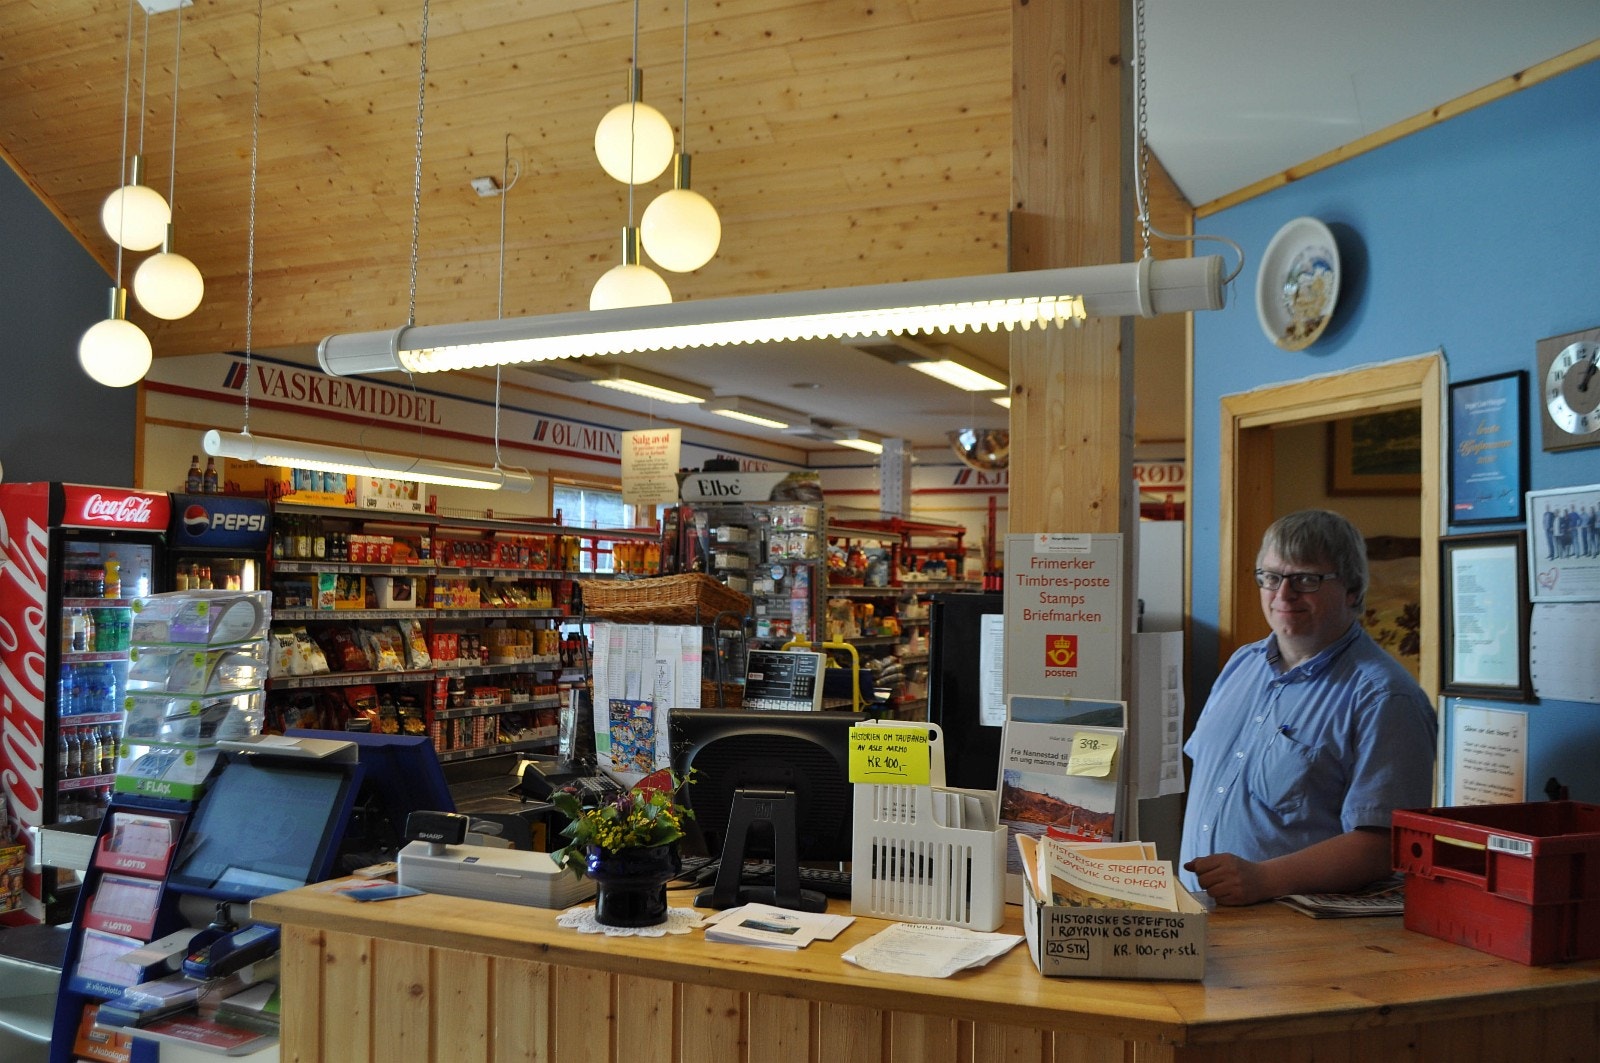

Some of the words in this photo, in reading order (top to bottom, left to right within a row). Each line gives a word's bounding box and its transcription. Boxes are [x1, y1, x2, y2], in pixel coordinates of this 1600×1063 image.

[256, 365, 442, 425] VASKEMIDDEL
[551, 420, 620, 454] ØL/MIN.
[83, 493, 153, 523] Coca-Cola
[211, 512, 266, 532] PEPSI
[1031, 557, 1095, 570] Frimerker
[1016, 574, 1110, 590] Timbres-poste
[1039, 591, 1085, 607] Stamps
[1023, 609, 1101, 622] Briefmarken
[1045, 669, 1078, 679] posten
[851, 732, 880, 741] HISTORIEN
[884, 733, 893, 741] OM
[869, 744, 883, 752] ASLE
[1010, 747, 1021, 755] Fra
[1023, 749, 1059, 760] Nannestad
[868, 755, 881, 767] KR
[1034, 758, 1056, 766] manns
[146, 781, 171, 794] FLAX
[418, 832, 444, 840] SHARP
[123, 860, 147, 869] LOTTO
[1048, 841, 1105, 870] HISTORISKE
[1108, 865, 1165, 876] STREIFTOG
[1056, 854, 1100, 879] RØYRVIK
[1103, 874, 1120, 884] OG
[1124, 877, 1167, 889] OMEGN
[109, 921, 132, 932] LOTTO
[1051, 912, 1119, 925] HISTORISKE
[1122, 915, 1185, 928] STREIFTOG
[1051, 927, 1054, 936] I
[1059, 926, 1109, 938] RØYRVIK
[1113, 927, 1130, 937] OG
[1135, 928, 1179, 939] OMEGN
[1050, 942, 1063, 953] 20
[1066, 943, 1086, 954] STK
[1113, 944, 1131, 957] KR.
[92, 982, 122, 996] vikinglotto
